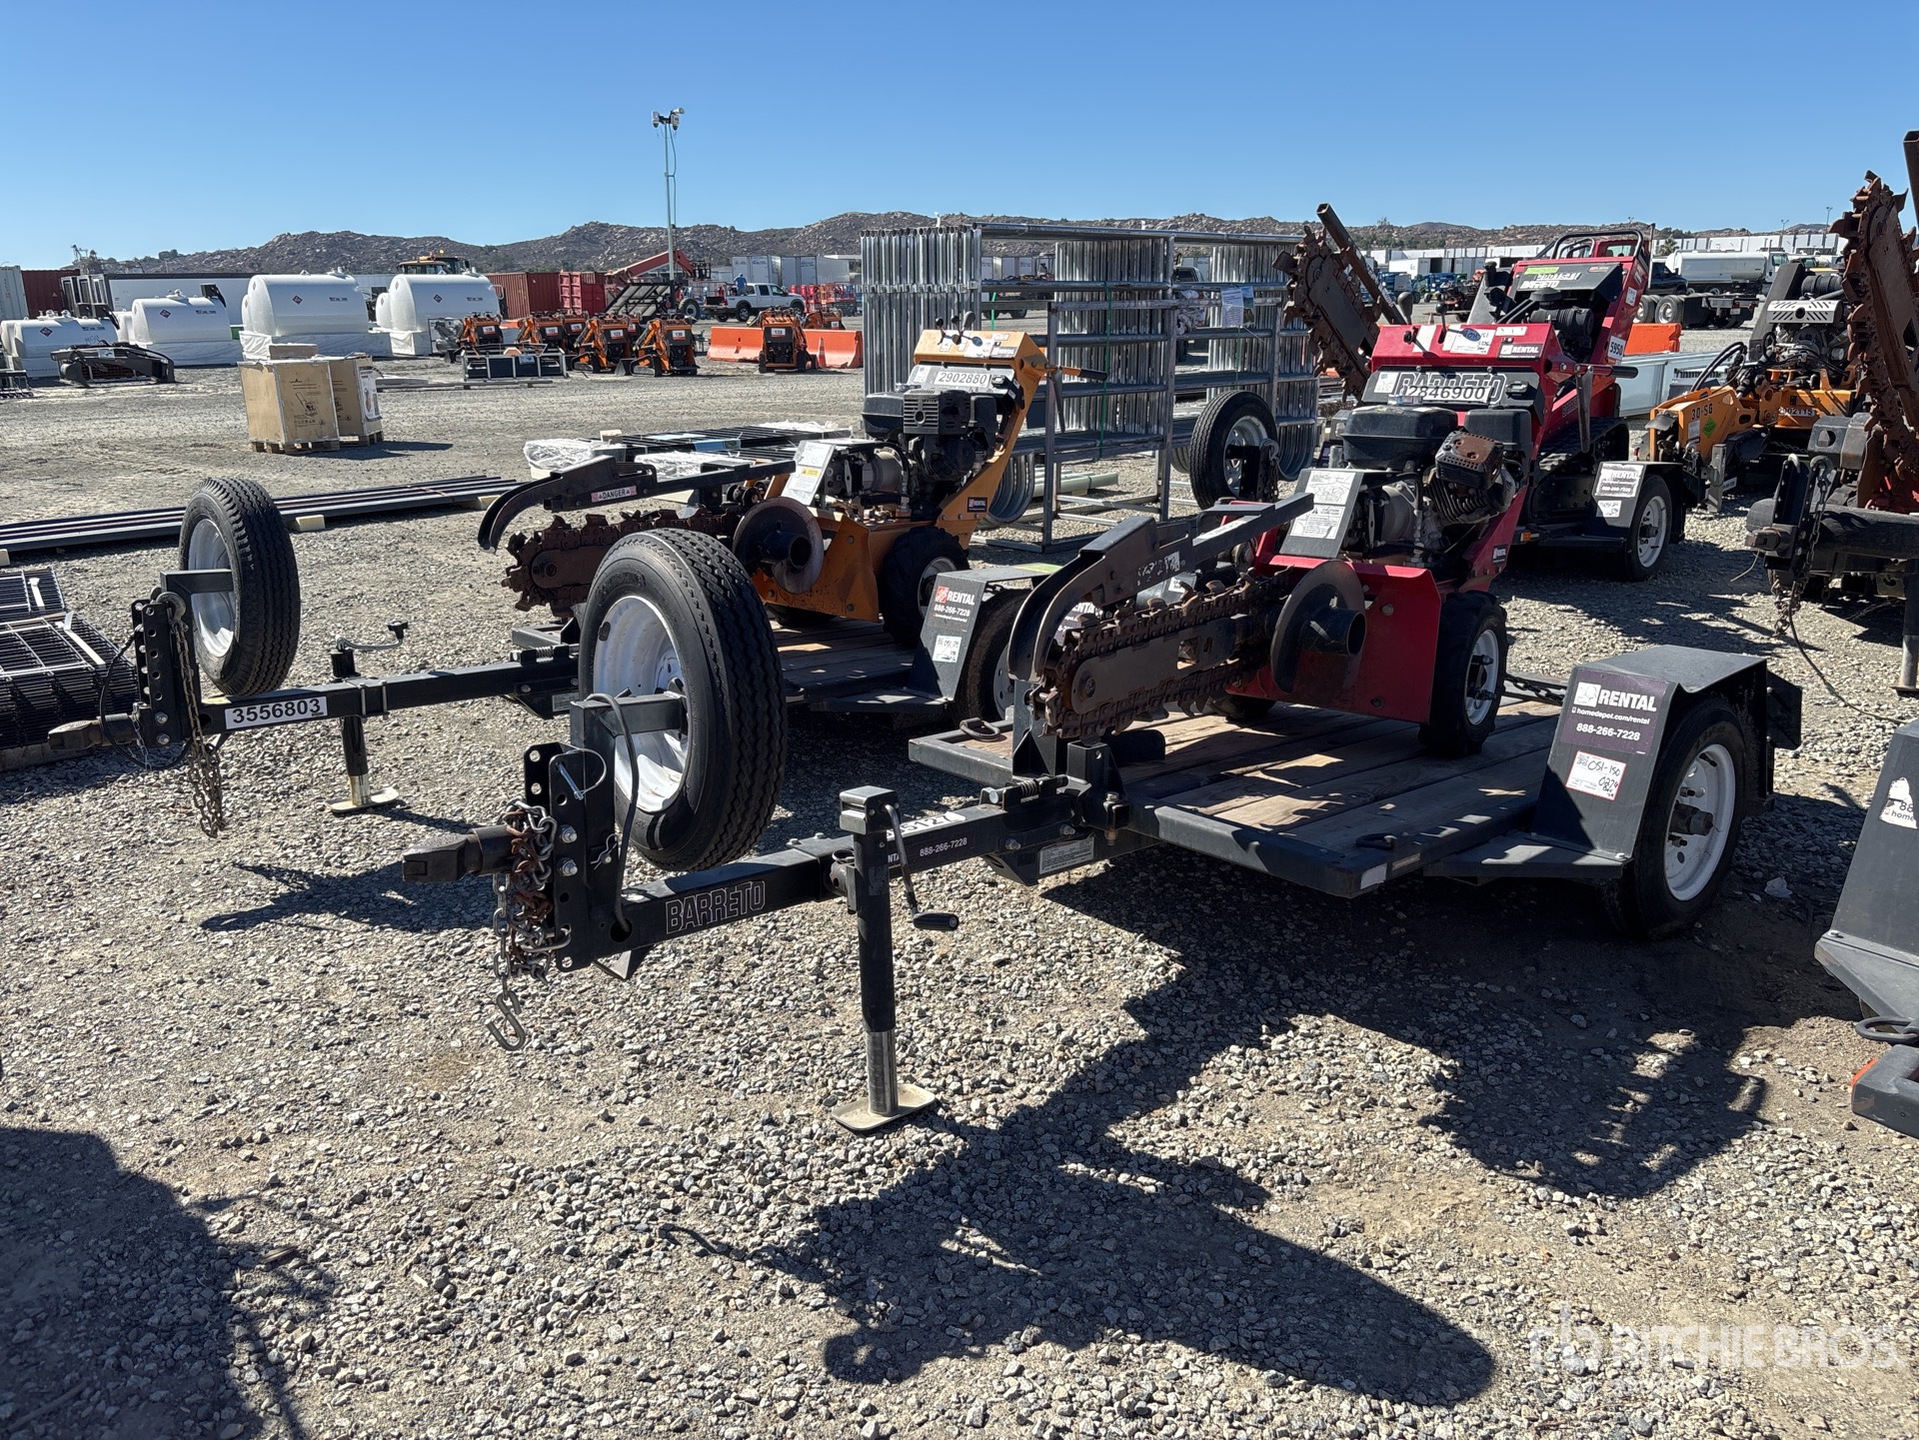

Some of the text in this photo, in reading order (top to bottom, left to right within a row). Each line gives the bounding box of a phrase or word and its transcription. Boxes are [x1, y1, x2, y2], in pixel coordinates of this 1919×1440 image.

[1511, 346, 1539, 354] RENTAL
[938, 372, 988, 385] 2902880
[1408, 385, 1486, 399] 2846900
[1691, 403, 1714, 421] 30-SG
[602, 489, 626, 499] DANGER
[947, 590, 976, 606] RENTAL
[1598, 689, 1657, 712] RENTAL
[232, 698, 321, 724] 3556803
[1577, 708, 1651, 725] homedepot.com/rental
[1576, 723, 1641, 741] 888-266-7228
[919, 837, 968, 857] 888-266-7228
[665, 880, 766, 935] BARRETO
